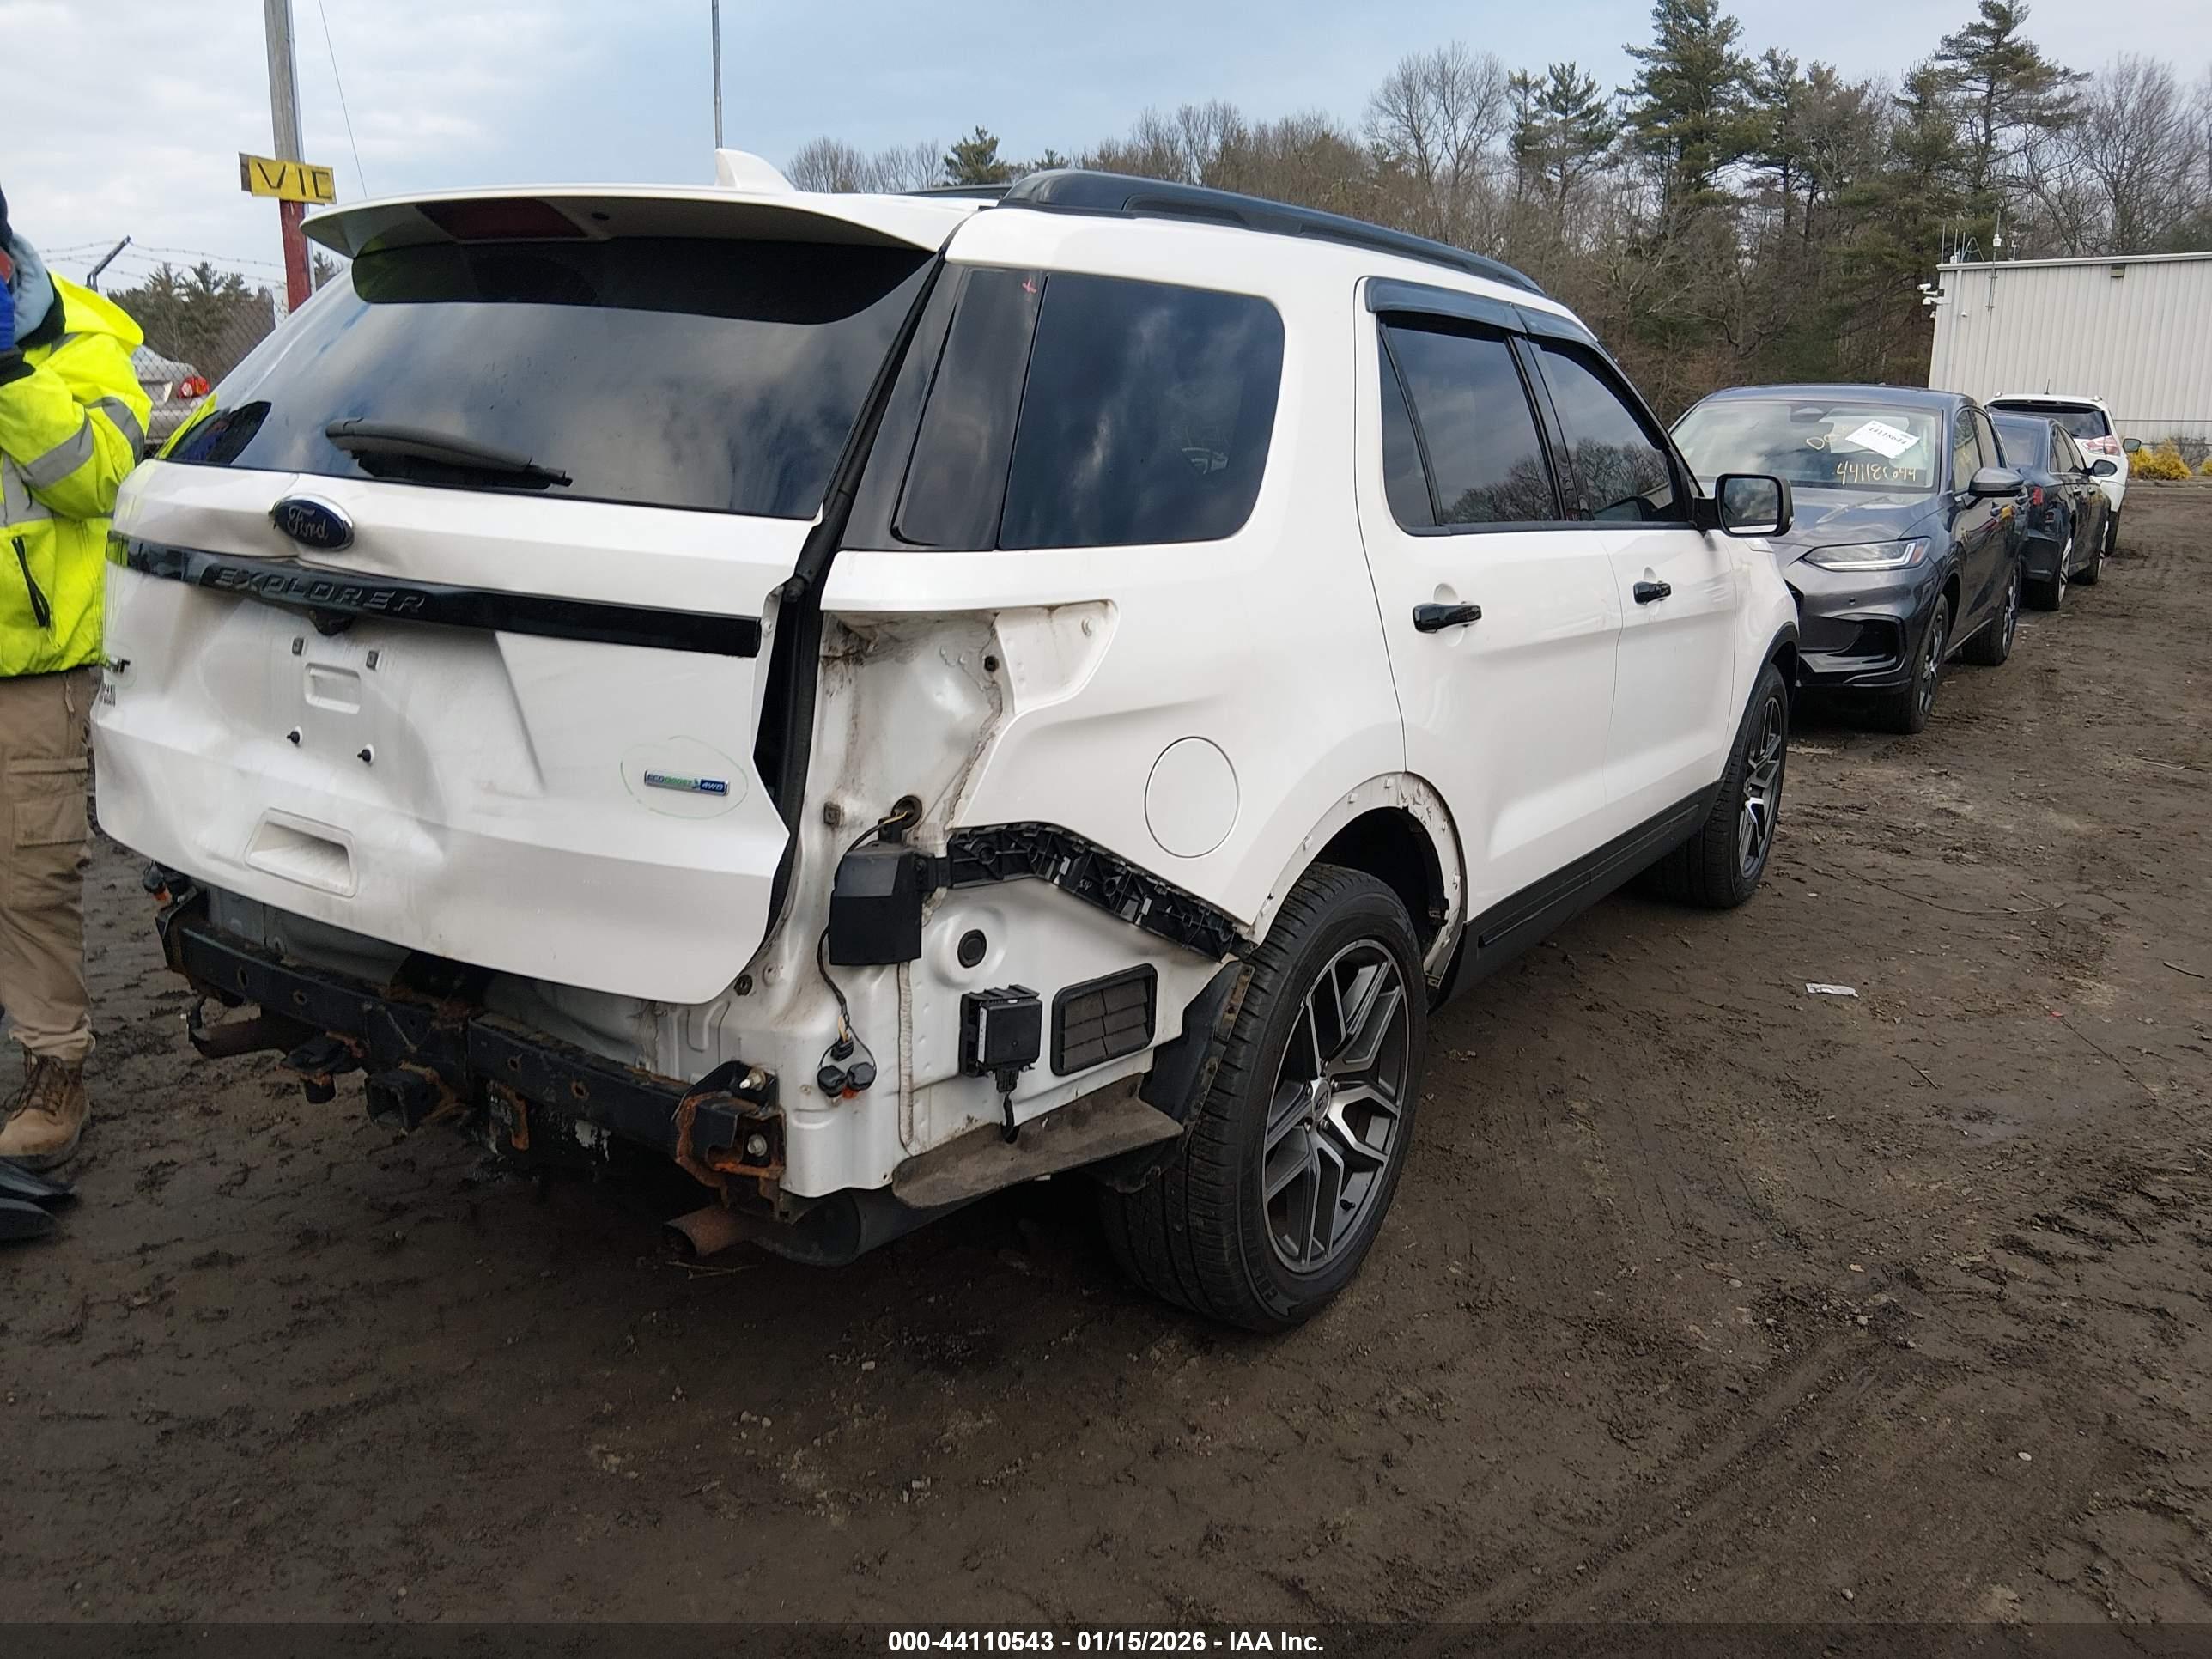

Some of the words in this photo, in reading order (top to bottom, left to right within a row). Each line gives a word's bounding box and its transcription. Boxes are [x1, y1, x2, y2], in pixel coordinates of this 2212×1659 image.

[287, 505, 329, 540] Ford
[216, 566, 426, 612] EXPLORER
[702, 781, 724, 791] 4WD
